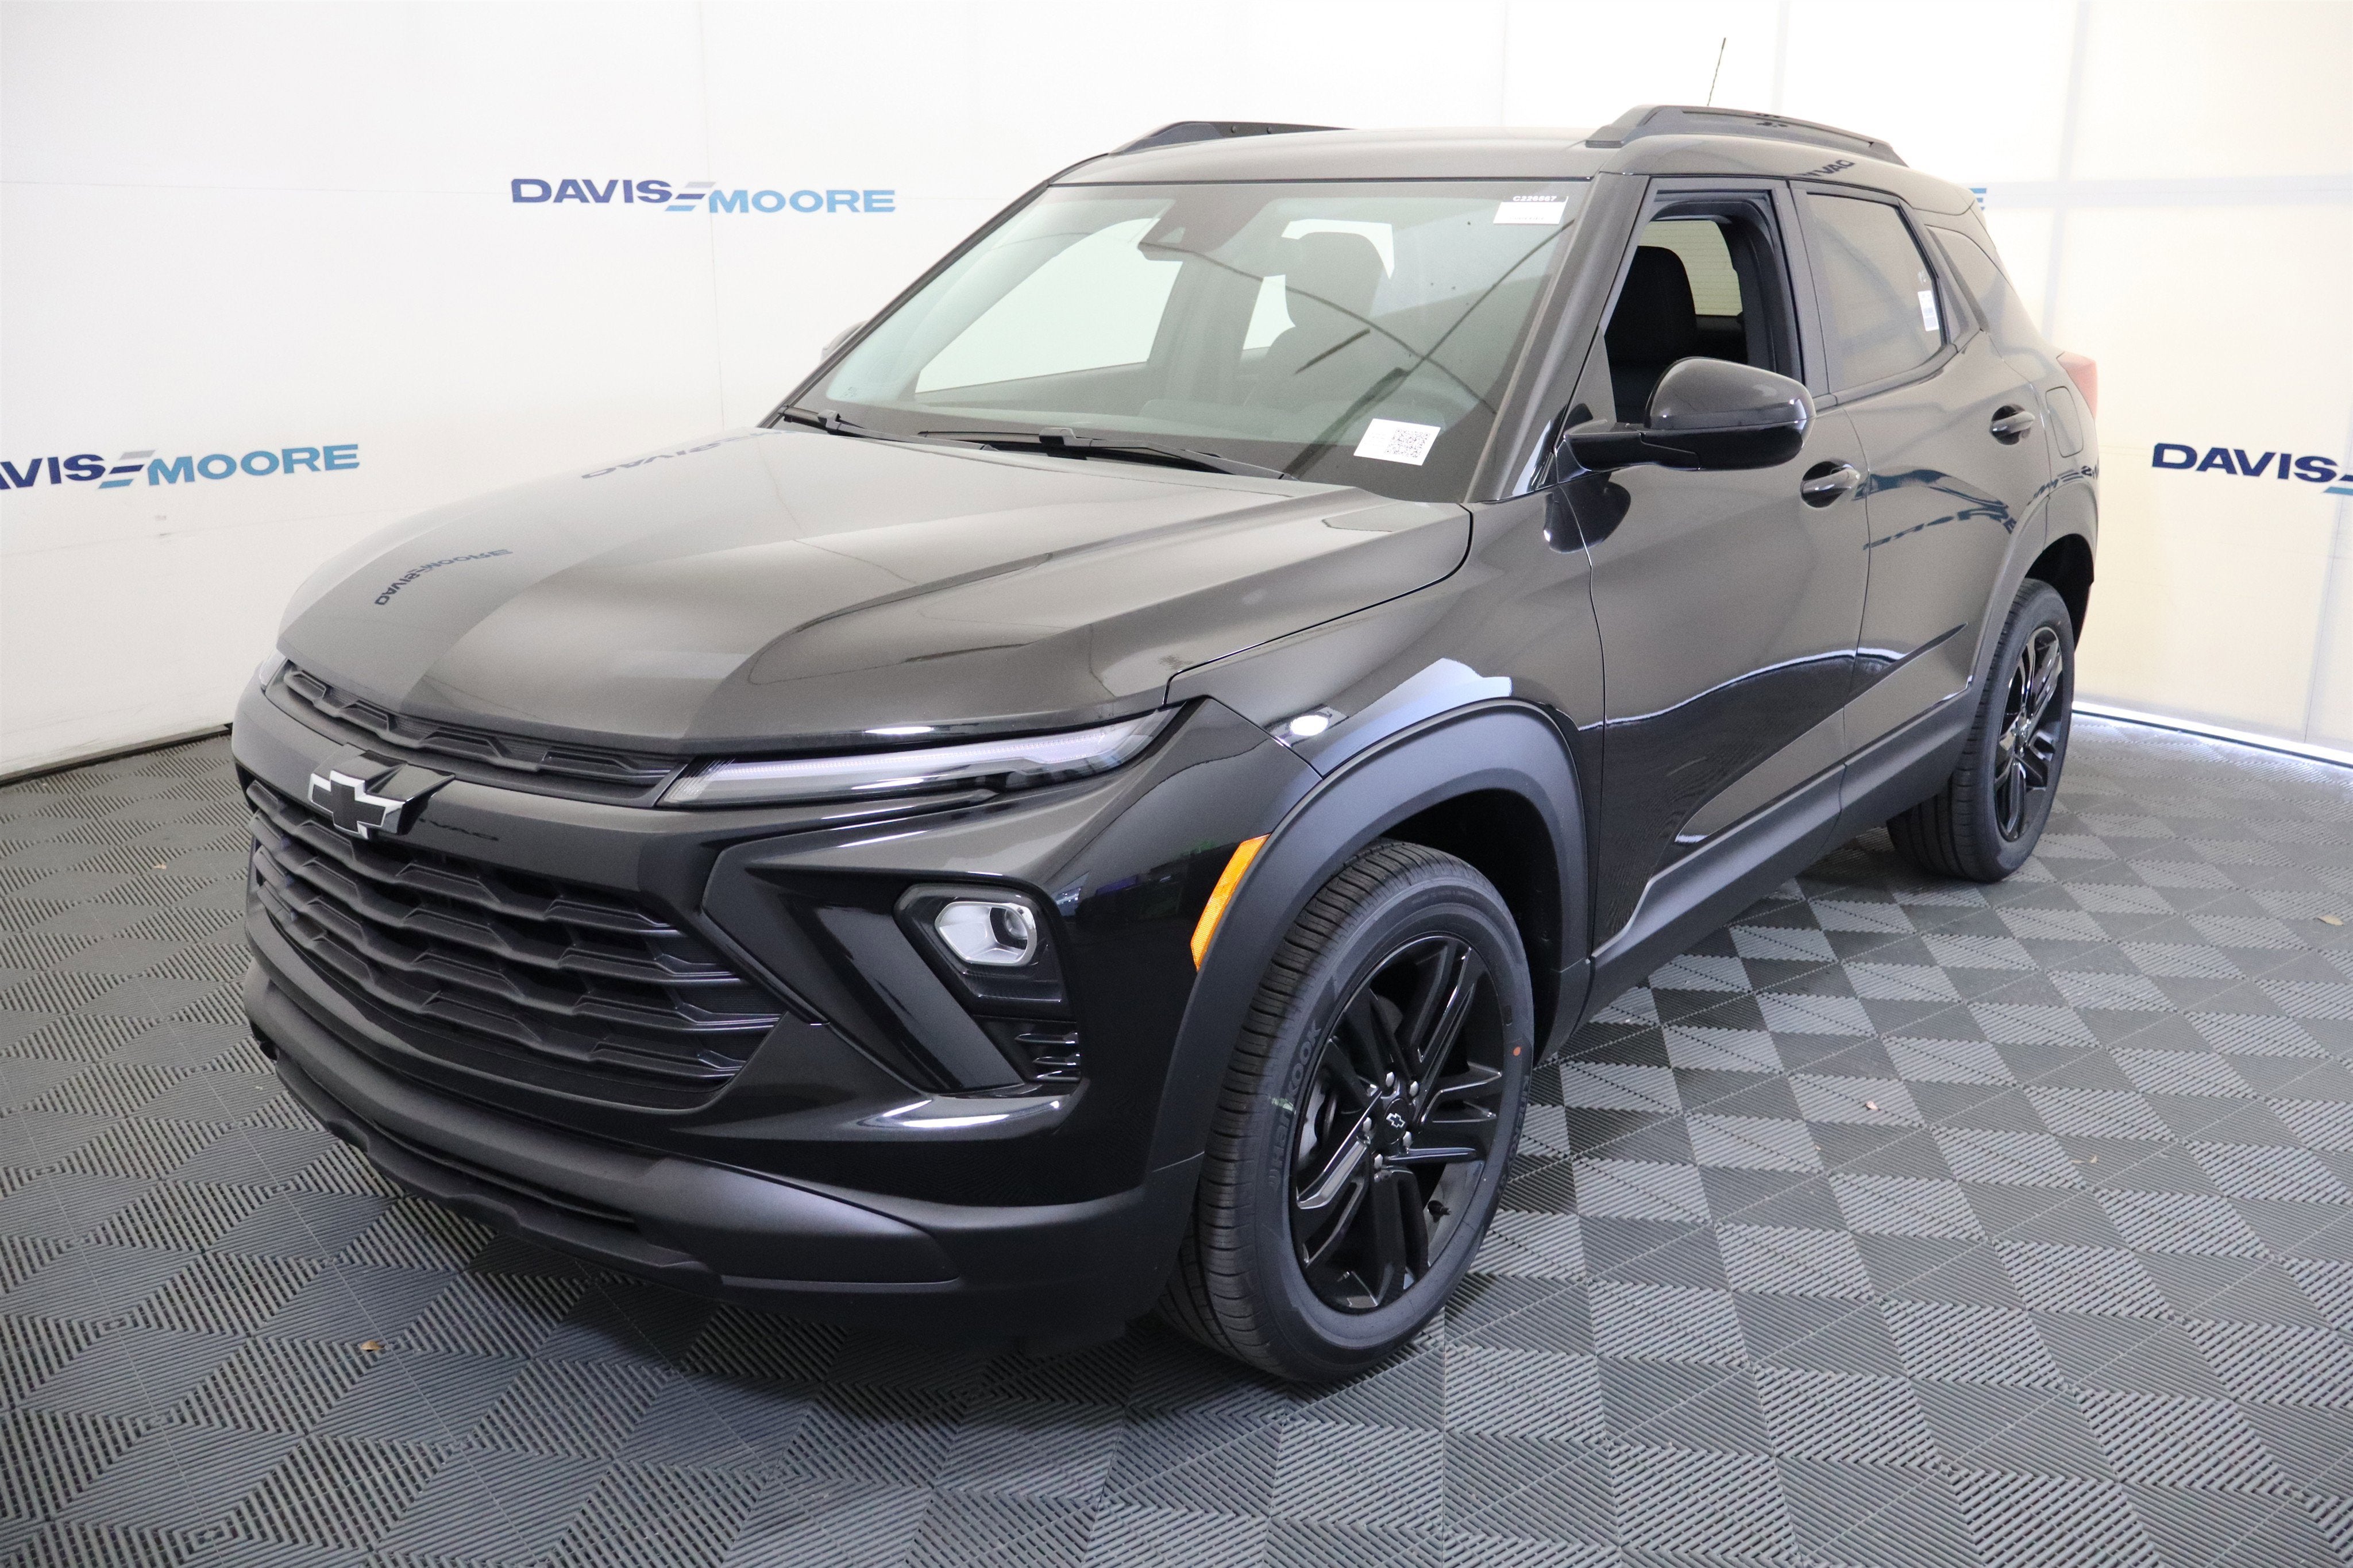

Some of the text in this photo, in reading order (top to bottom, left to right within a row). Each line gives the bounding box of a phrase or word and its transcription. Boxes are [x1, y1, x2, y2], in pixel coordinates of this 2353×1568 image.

[511, 178, 896, 214] DAVIS MOORE
[0, 444, 360, 491] VIS MOORE
[2151, 443, 2337, 483] DAVIS
